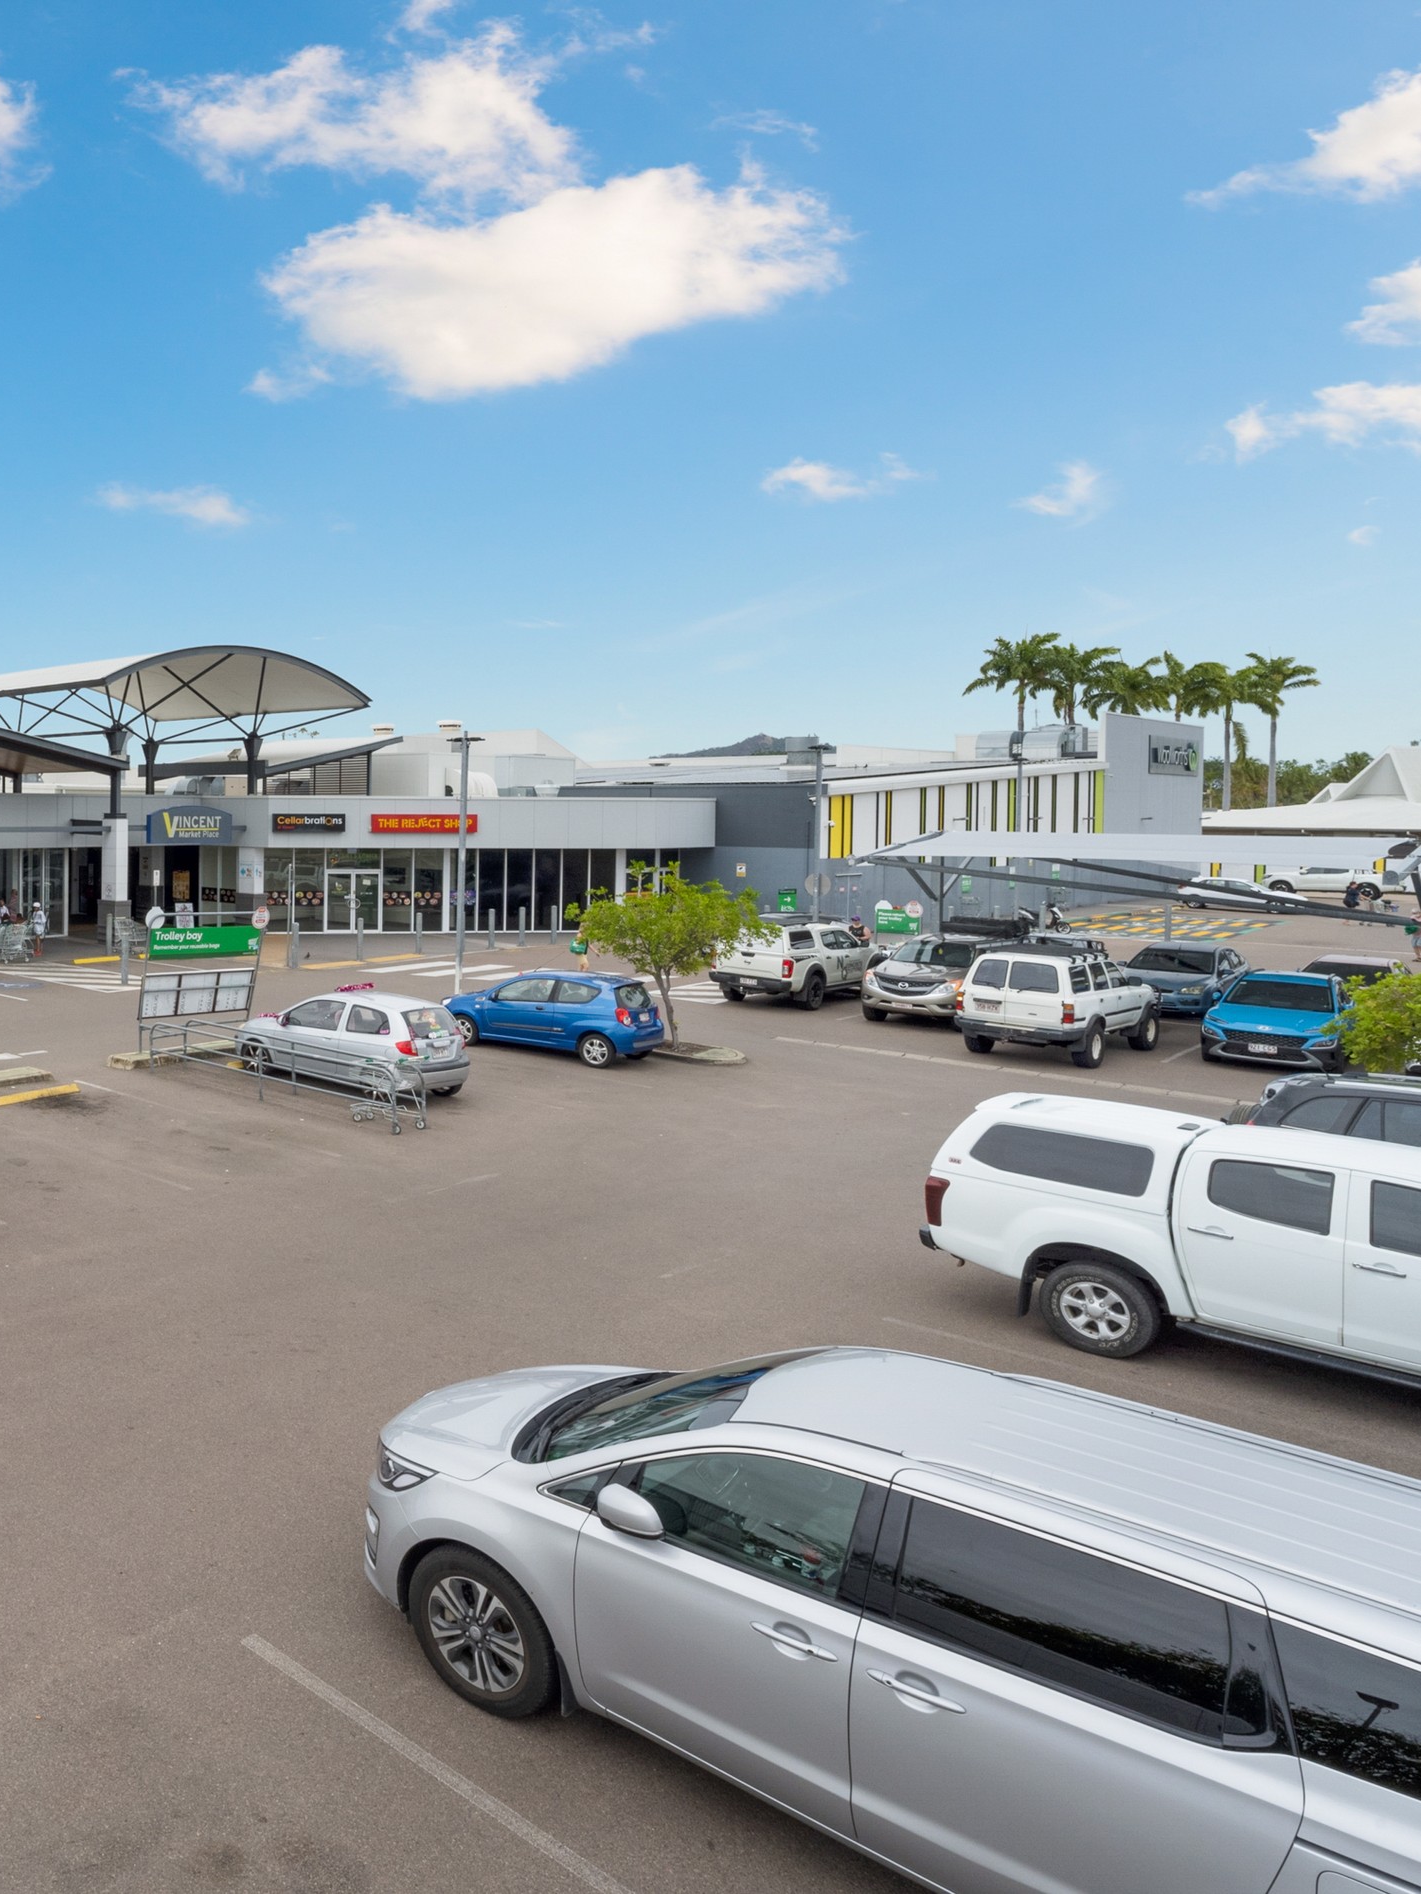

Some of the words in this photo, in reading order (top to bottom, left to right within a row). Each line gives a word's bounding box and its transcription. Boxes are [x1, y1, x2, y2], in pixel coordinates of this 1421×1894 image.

[162, 811, 222, 838] VINCENT
[277, 815, 344, 826] Cellarbrations
[378, 818, 399, 829] THE
[401, 817, 442, 829] REJECT
[443, 818, 473, 829] SHP
[155, 931, 185, 942] Trolley
[186, 931, 203, 942] bay
